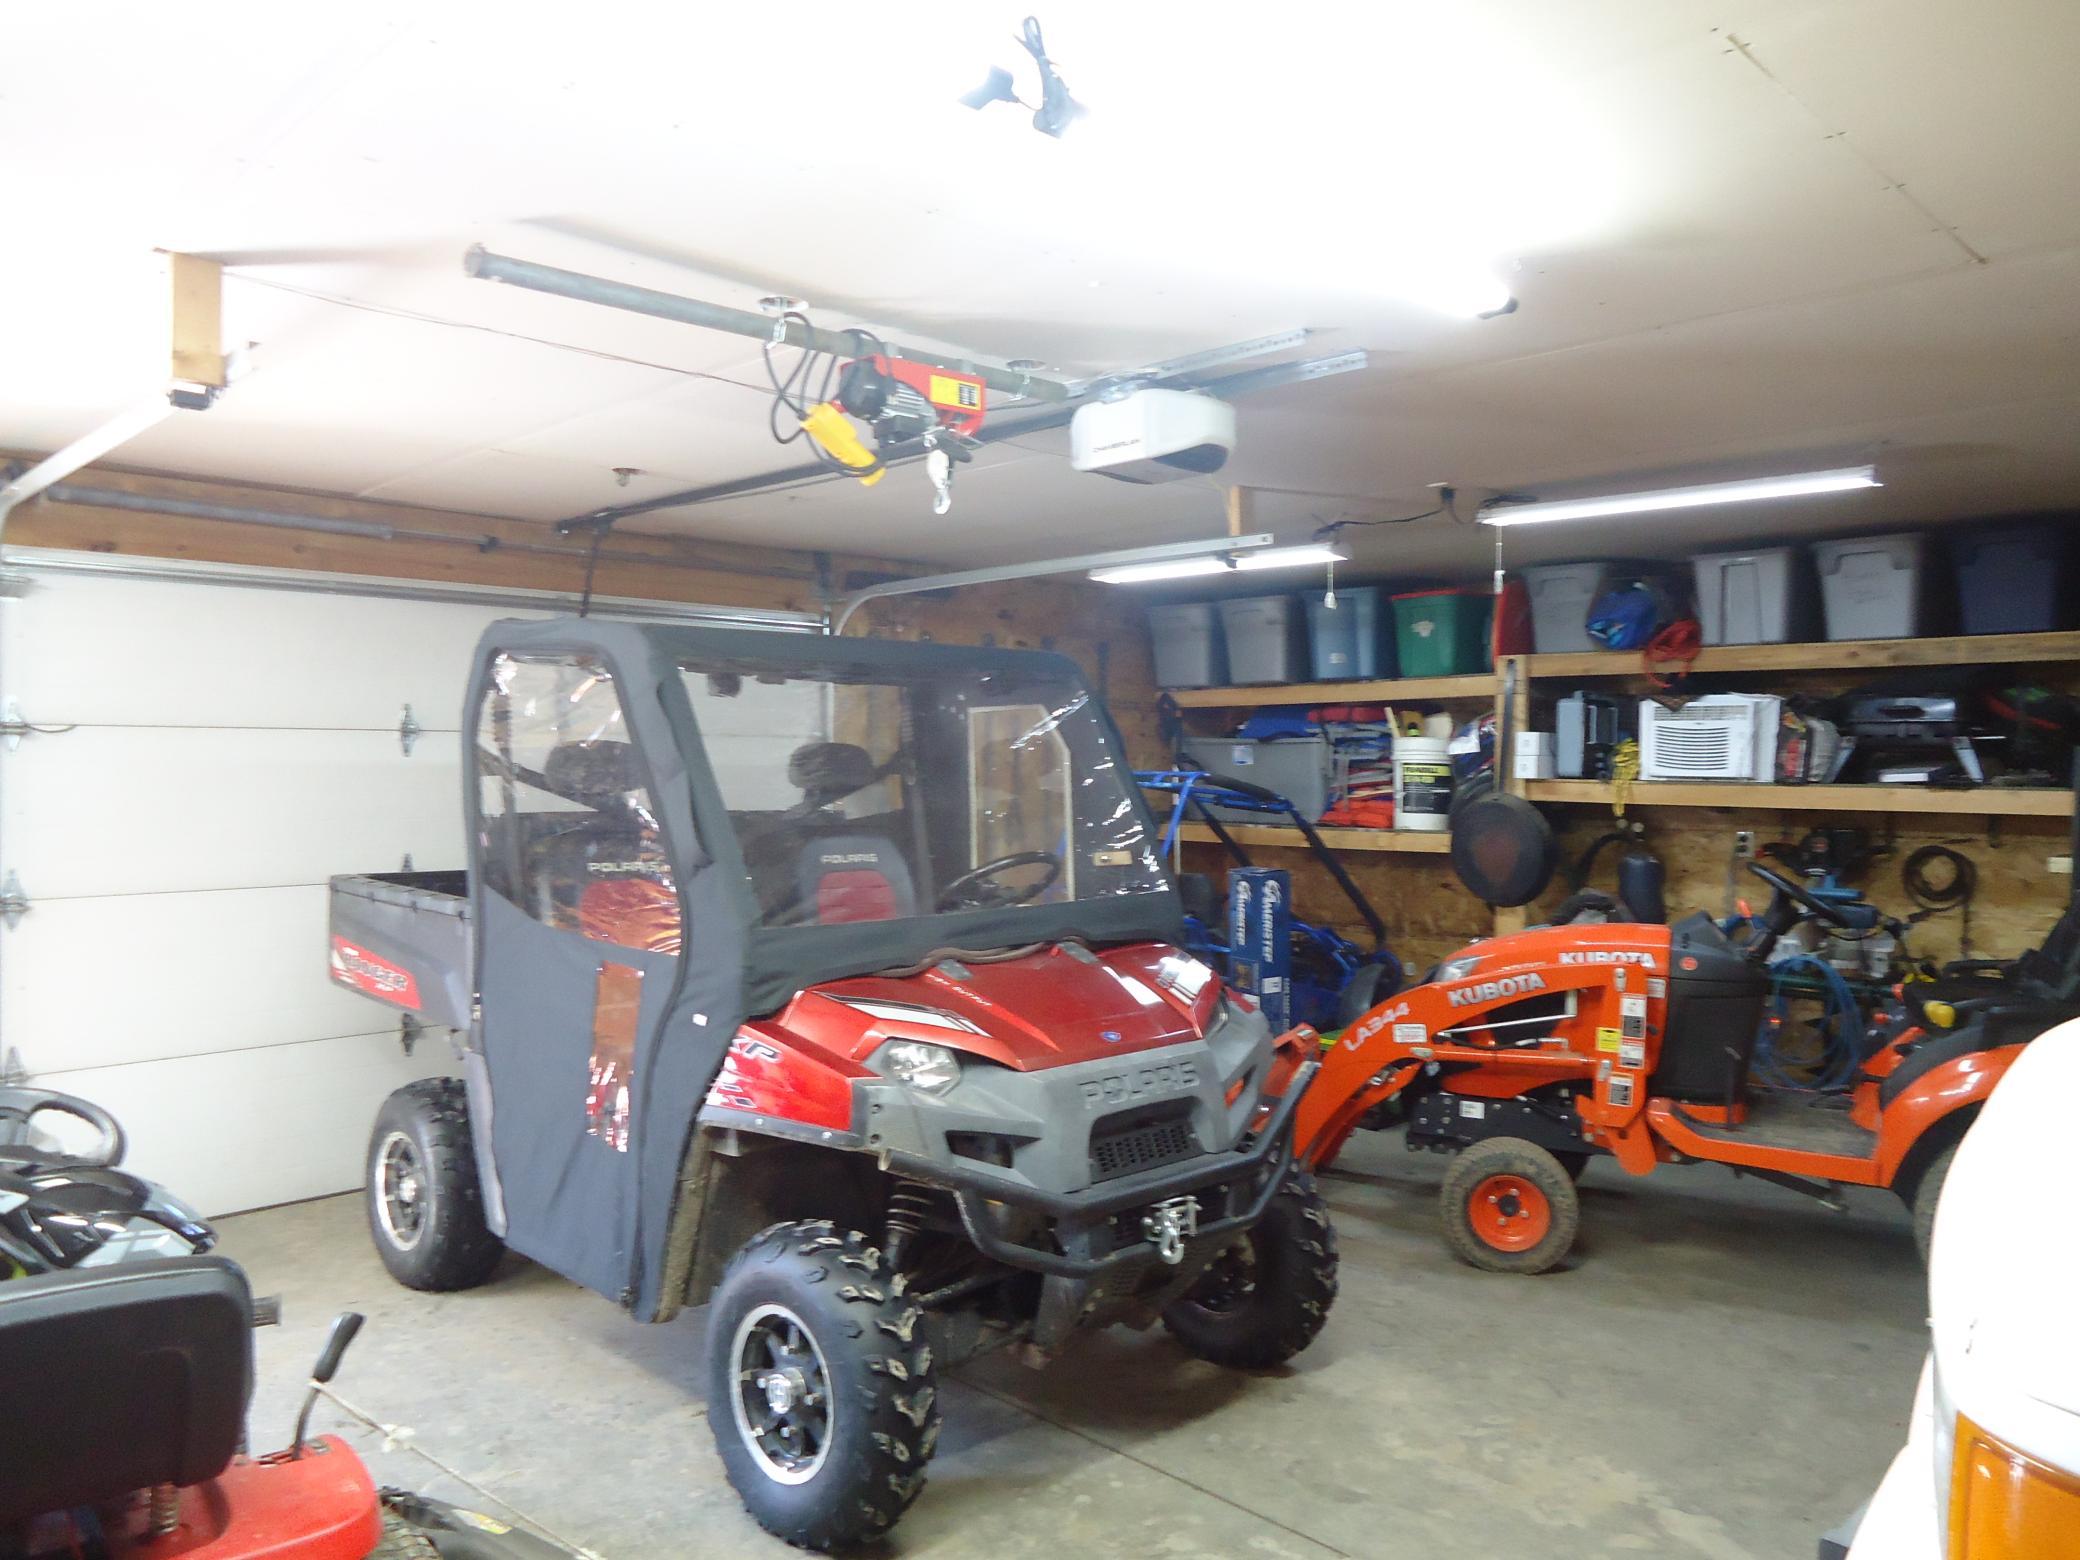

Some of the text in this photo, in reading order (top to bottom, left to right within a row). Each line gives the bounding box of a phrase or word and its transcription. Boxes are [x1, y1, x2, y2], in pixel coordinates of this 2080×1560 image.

[820, 853, 879, 864] POLARIS
[1261, 884, 1280, 963] AMERISTEP
[1559, 951, 1657, 969] KUBOTA
[1446, 972, 1547, 1008] KUBOTA
[1343, 1002, 1410, 1051] LA344
[1079, 1061, 1200, 1109] POLARIS
